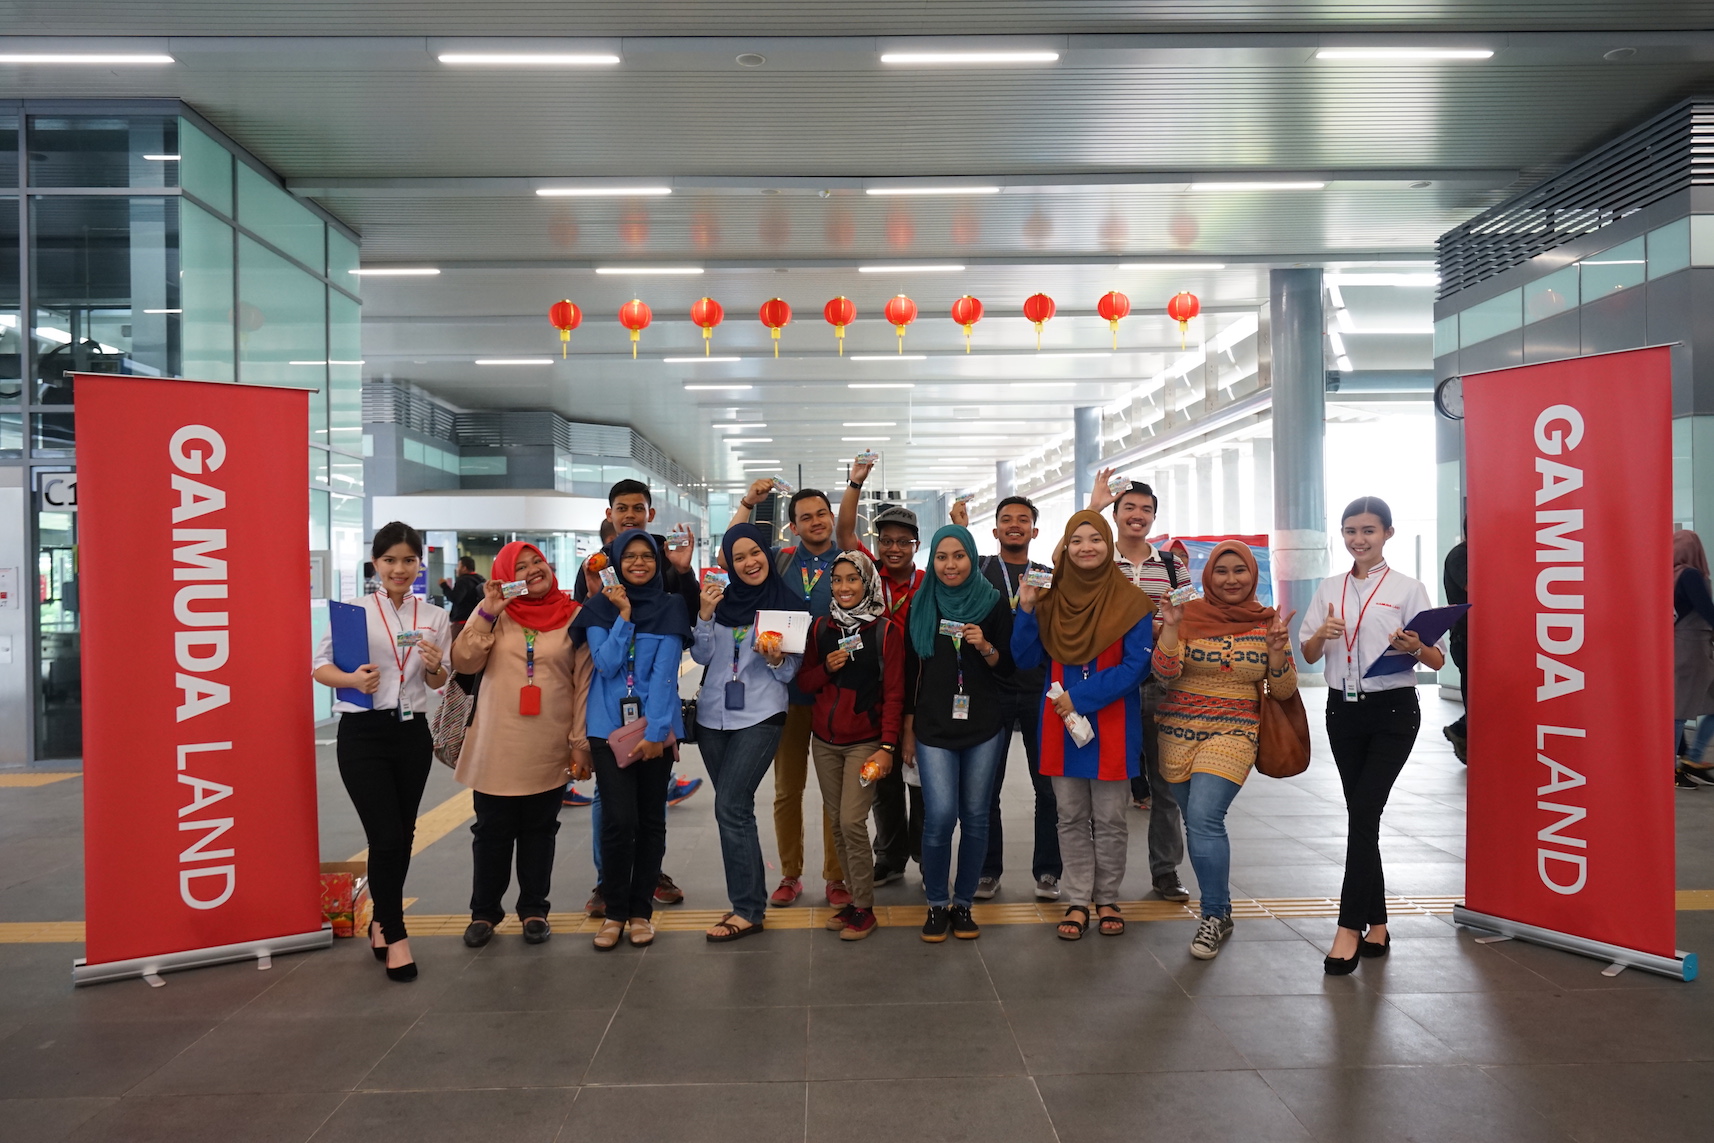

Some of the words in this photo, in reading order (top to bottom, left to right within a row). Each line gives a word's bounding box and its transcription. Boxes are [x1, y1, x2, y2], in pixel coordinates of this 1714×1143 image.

[168, 424, 231, 723] GAMUDA
[1533, 404, 1585, 703] GAMUDA
[176, 741, 236, 910] LAND
[1536, 726, 1587, 895] LAND
